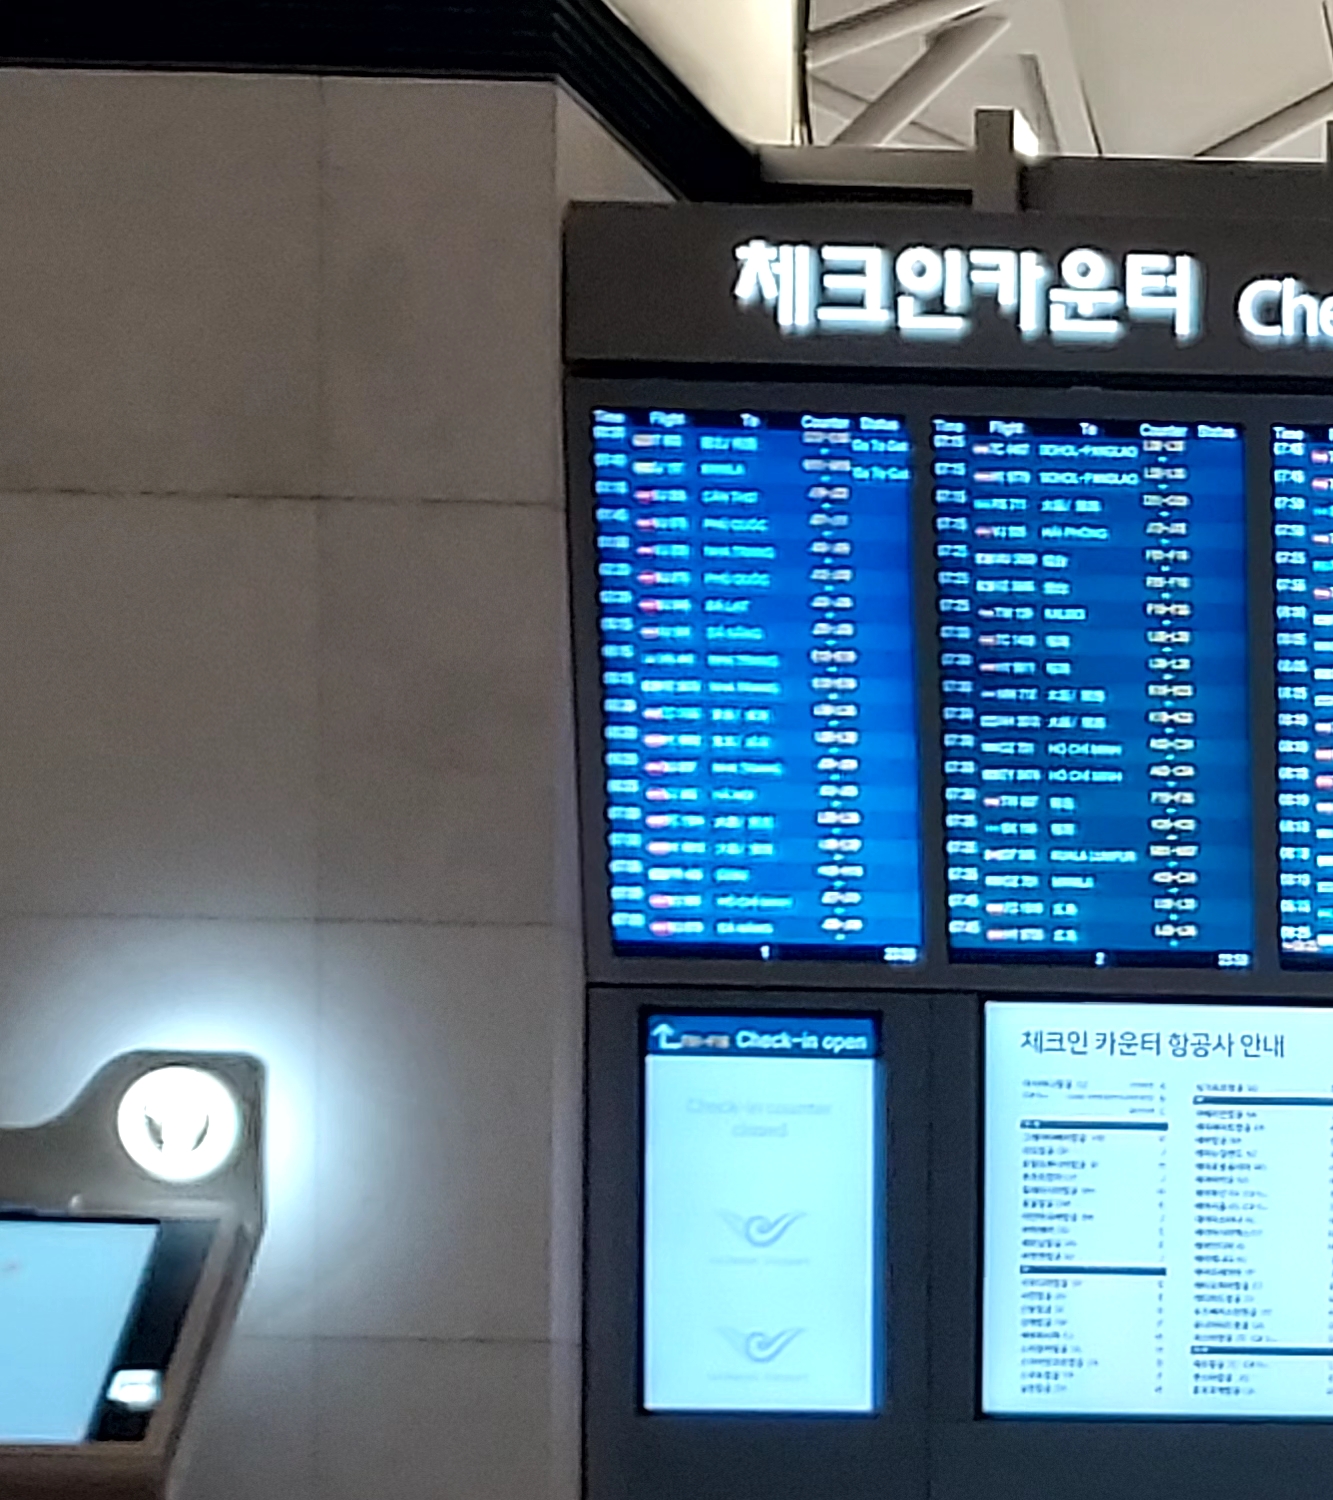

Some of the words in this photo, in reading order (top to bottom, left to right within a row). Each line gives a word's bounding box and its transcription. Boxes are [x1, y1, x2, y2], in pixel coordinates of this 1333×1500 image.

[735, 240, 1198, 339] 체크인카운터
[1273, 426, 1305, 441] Time
[735, 1030, 819, 1049] Check-in
[821, 1035, 868, 1053] open
[1021, 1030, 1088, 1056] 체크인
[1095, 1031, 1161, 1057] 카운터
[1168, 1032, 1234, 1058] 항공사
[1240, 1034, 1285, 1058] 안내
